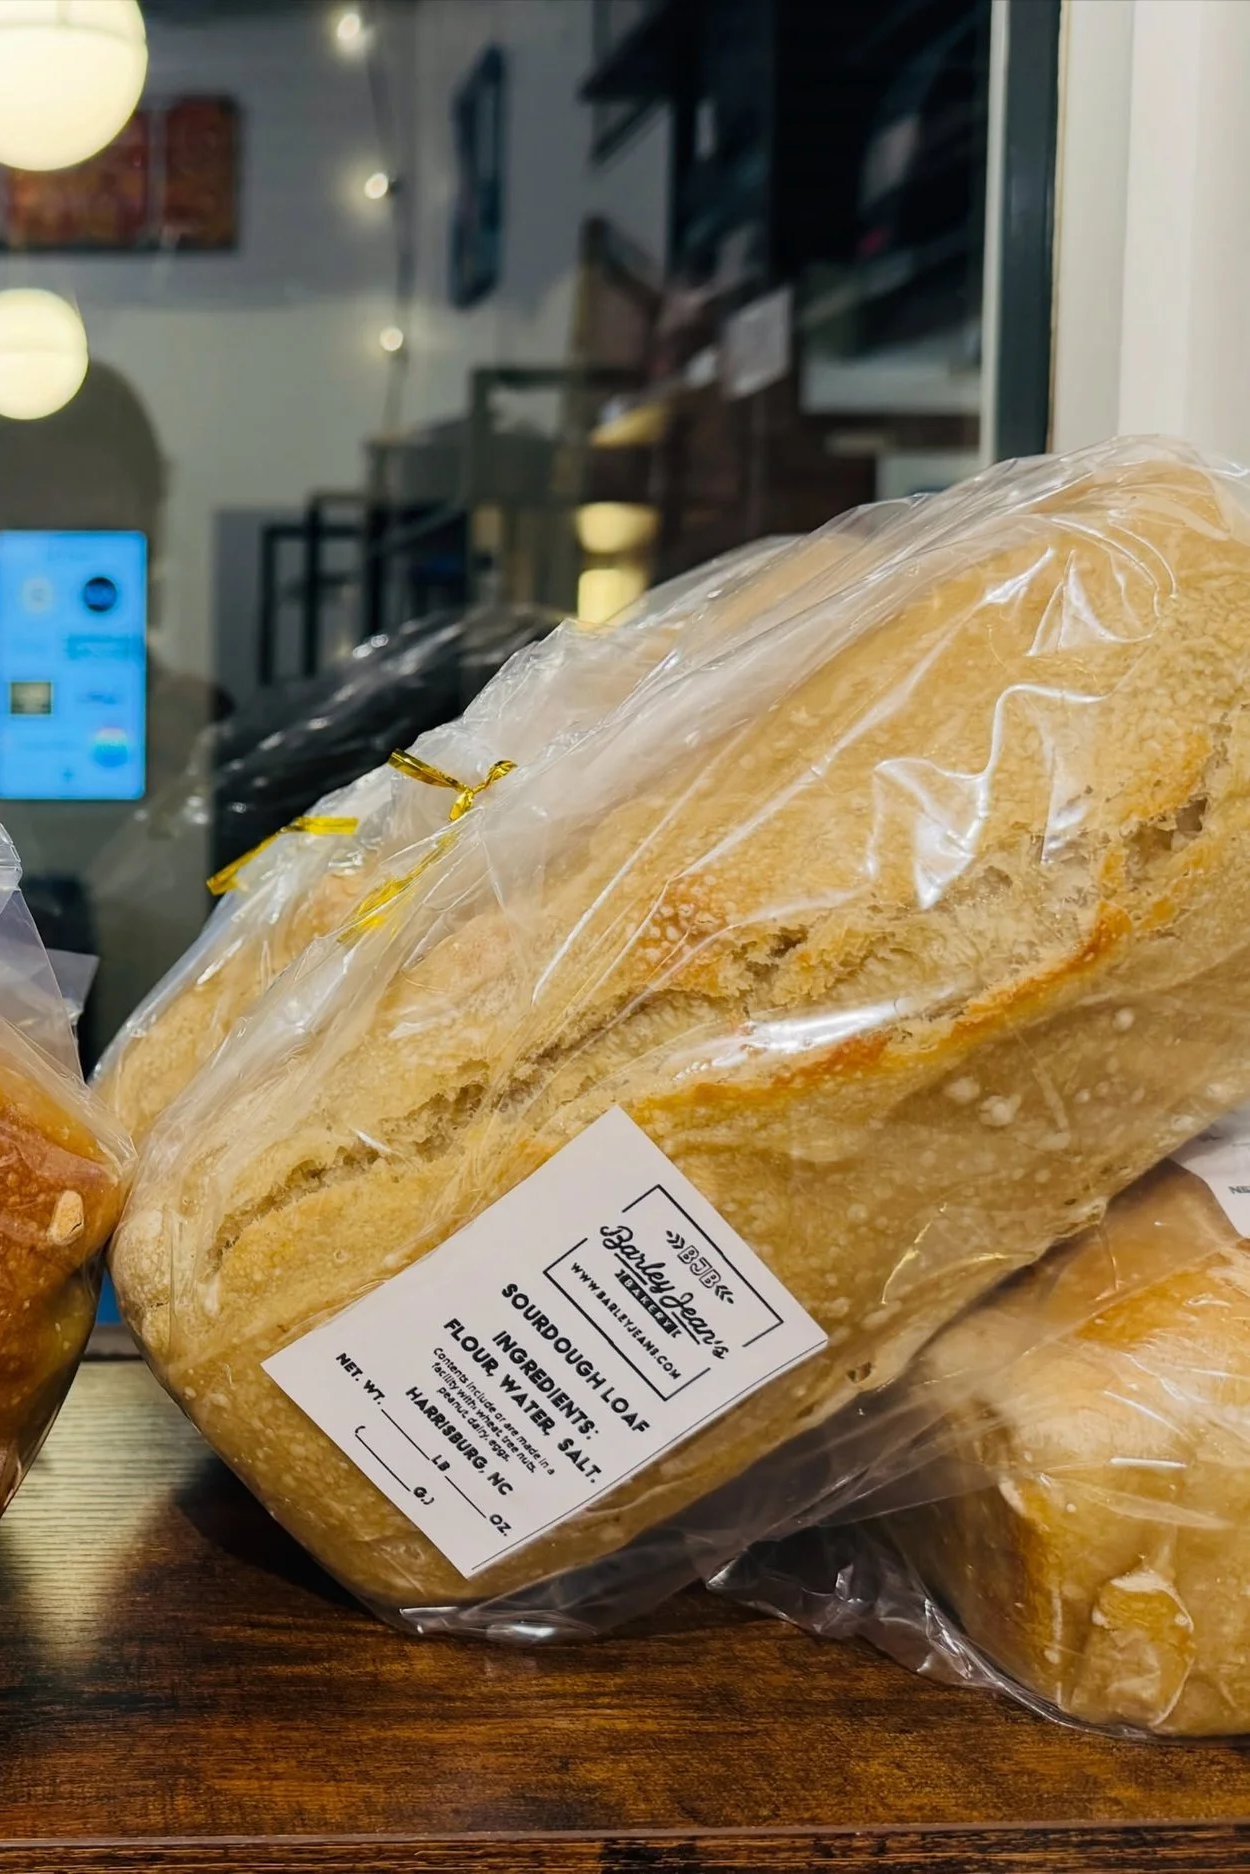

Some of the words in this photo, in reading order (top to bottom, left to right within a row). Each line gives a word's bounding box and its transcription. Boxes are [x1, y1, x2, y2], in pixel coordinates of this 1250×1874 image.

[571, 1262, 681, 1380] WWW.BARLEYJEANS.COM
[600, 1225, 673, 1294] Barley
[659, 1289, 730, 1360] Jean's
[622, 1277, 674, 1331] BAKERY
[678, 1245, 721, 1289] BJB
[432, 1362, 460, 1390] facility
[501, 1435, 519, 1453] tree
[433, 1348, 469, 1384] Contents
[466, 1382, 497, 1413] include
[494, 1413, 506, 1422] or
[503, 1423, 519, 1436] are
[516, 1436, 541, 1460] made
[539, 1458, 549, 1468] in
[443, 1318, 499, 1377] FLOUR,
[499, 1374, 555, 1436] WATER,
[557, 1438, 602, 1483] SALT.
[492, 1330, 599, 1440] INGREDIENTS:
[502, 1284, 606, 1390] SOURDOUGH
[600, 1387, 650, 1432] LOAF
[335, 1353, 363, 1381] NET.
[363, 1379, 385, 1405] WT.
[431, 1454, 450, 1472] LB
[489, 1514, 512, 1536] OZ.
[405, 1386, 488, 1473] HARRISBURG,
[487, 1472, 513, 1496] NC
[489, 1439, 510, 1462] eggs.
